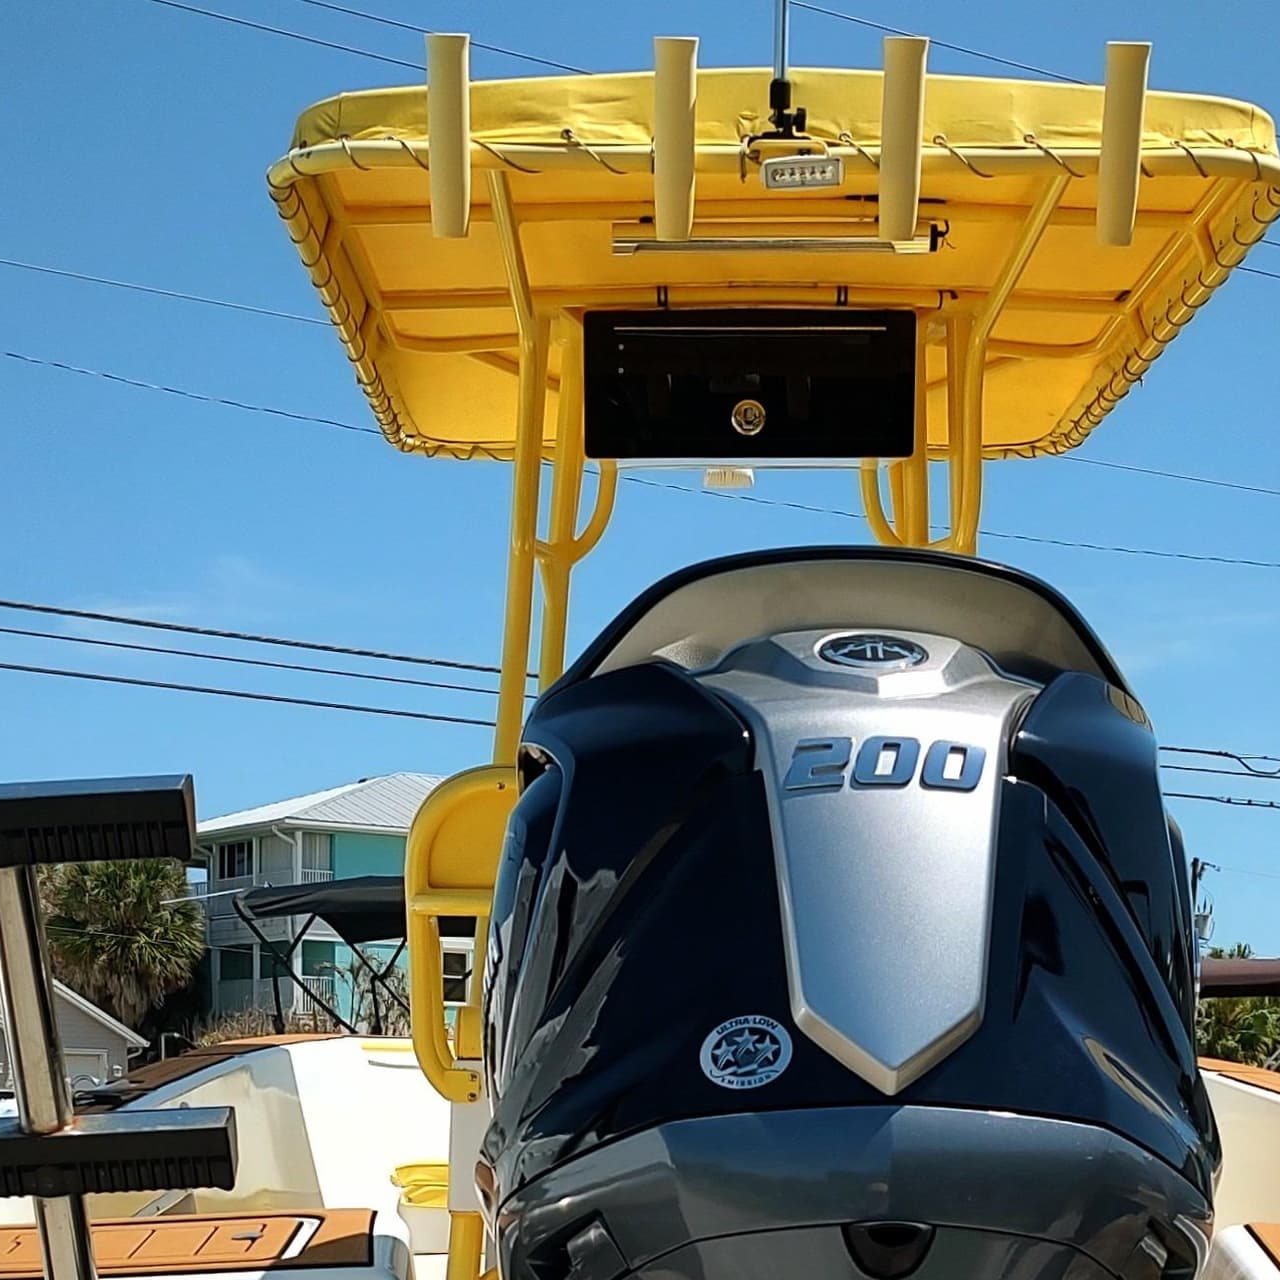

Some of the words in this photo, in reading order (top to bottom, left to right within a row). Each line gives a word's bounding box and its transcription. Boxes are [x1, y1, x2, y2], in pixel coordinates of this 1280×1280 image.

[782, 736, 987, 791] 200
[716, 1017, 750, 1035] ULTRA
[753, 1017, 778, 1030] LOW
